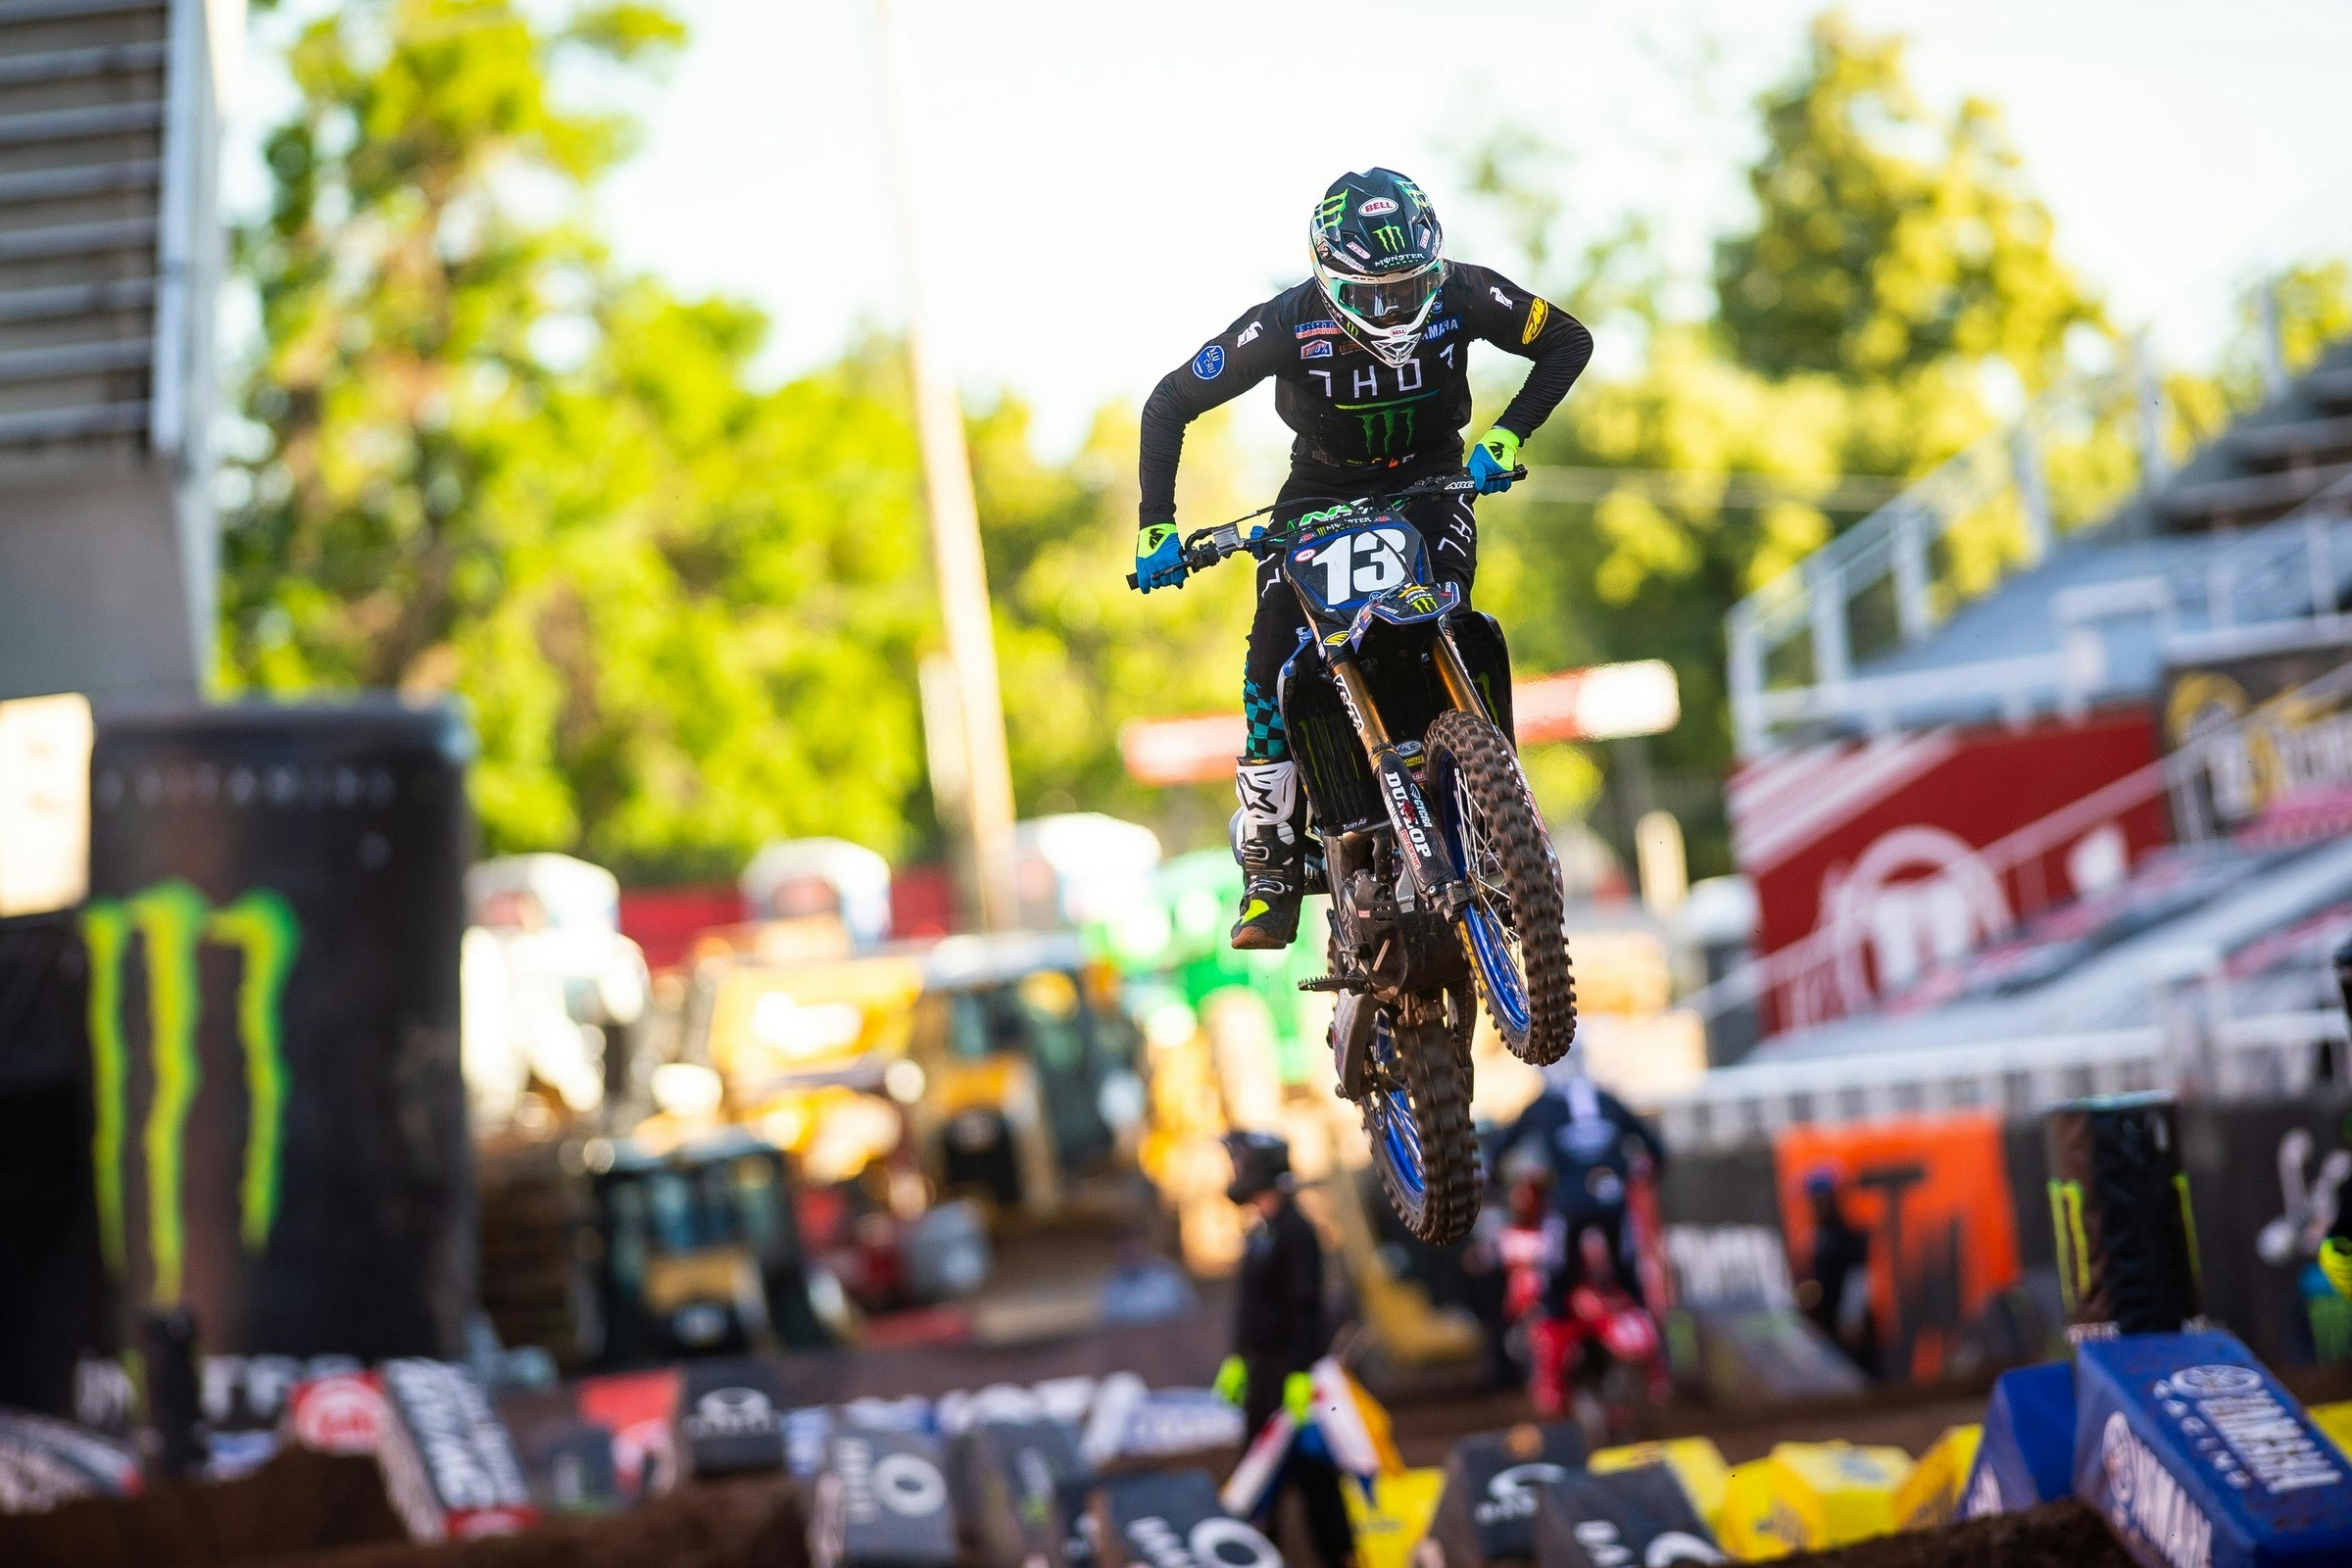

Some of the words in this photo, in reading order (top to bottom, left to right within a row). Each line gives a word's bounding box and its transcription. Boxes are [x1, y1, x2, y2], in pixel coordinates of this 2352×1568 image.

[1365, 201, 1393, 213] BELL
[1375, 252, 1425, 268] MONSTER
[1421, 318, 1459, 340] AMAHA
[1444, 480, 1475, 490] ARC
[1312, 528, 1407, 606] 13
[1414, 799, 1433, 828] CYCRA
[1342, 821, 1358, 831] Twin
[1402, 830, 1421, 869] BRAKING
